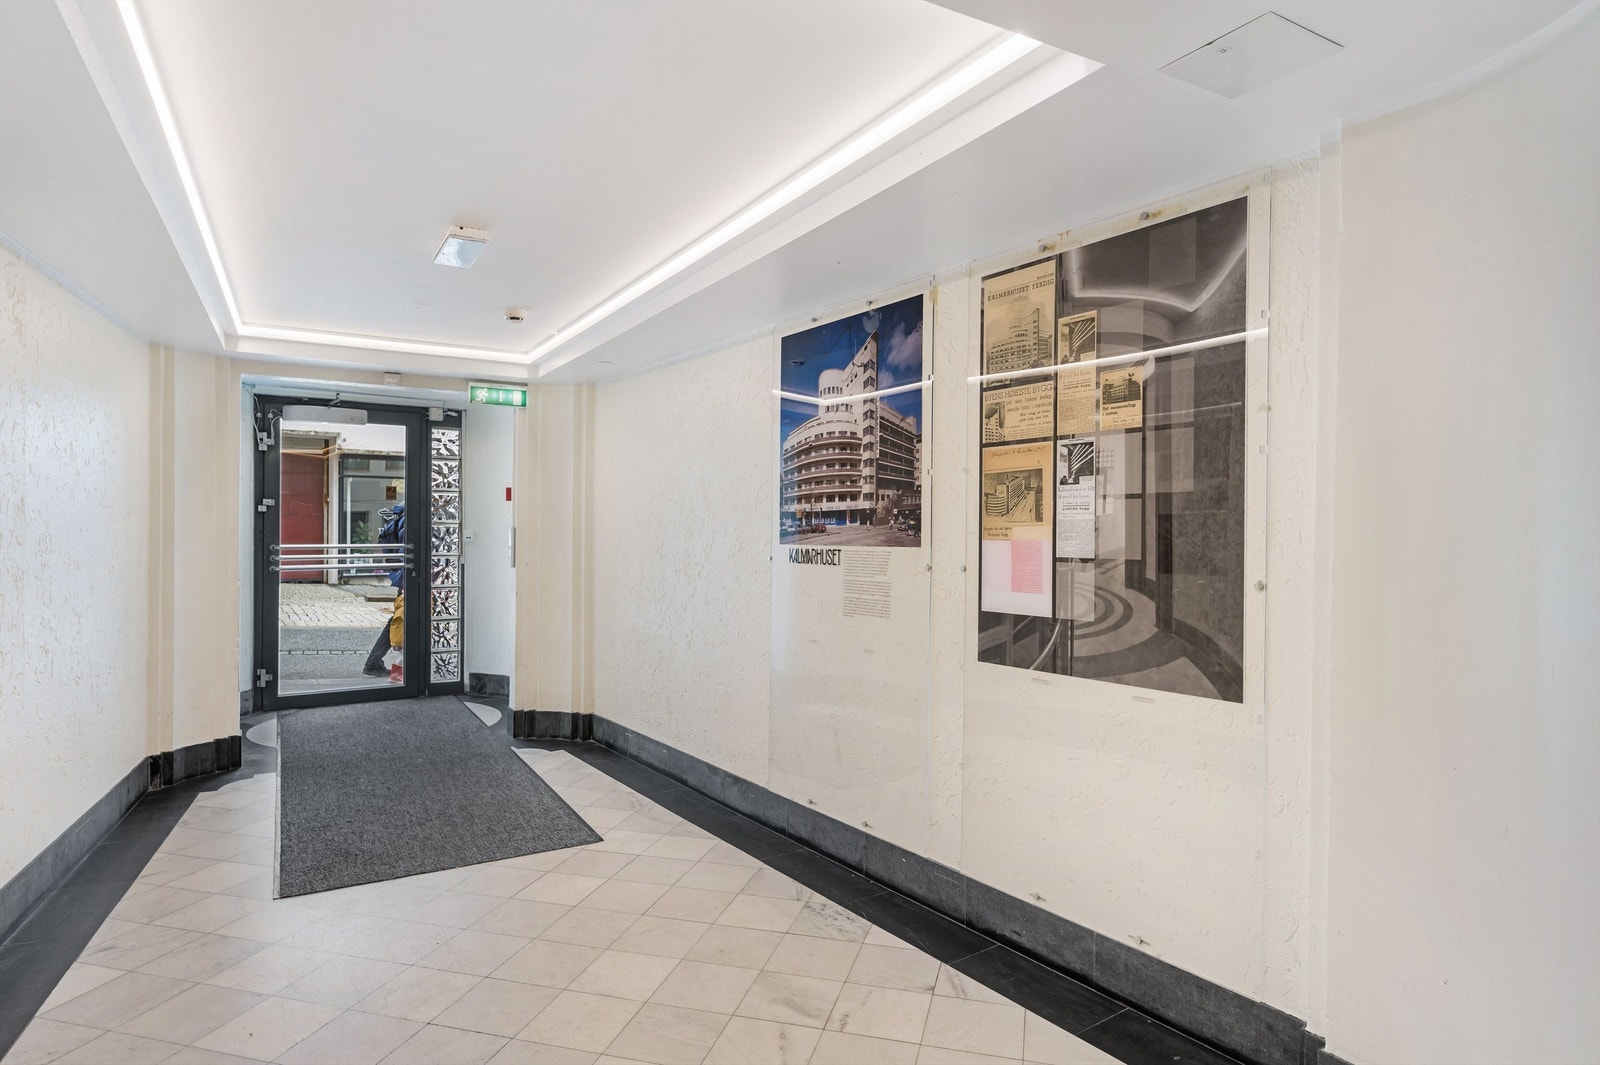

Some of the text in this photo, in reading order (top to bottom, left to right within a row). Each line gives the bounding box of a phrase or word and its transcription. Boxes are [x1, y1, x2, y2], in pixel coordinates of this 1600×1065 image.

[988, 279, 1054, 301] KALMARHUSET FERDIG
[985, 391, 1004, 402] BYENS
[1032, 384, 1052, 395] BYGG
[789, 548, 841, 566] KALMARHUSET
